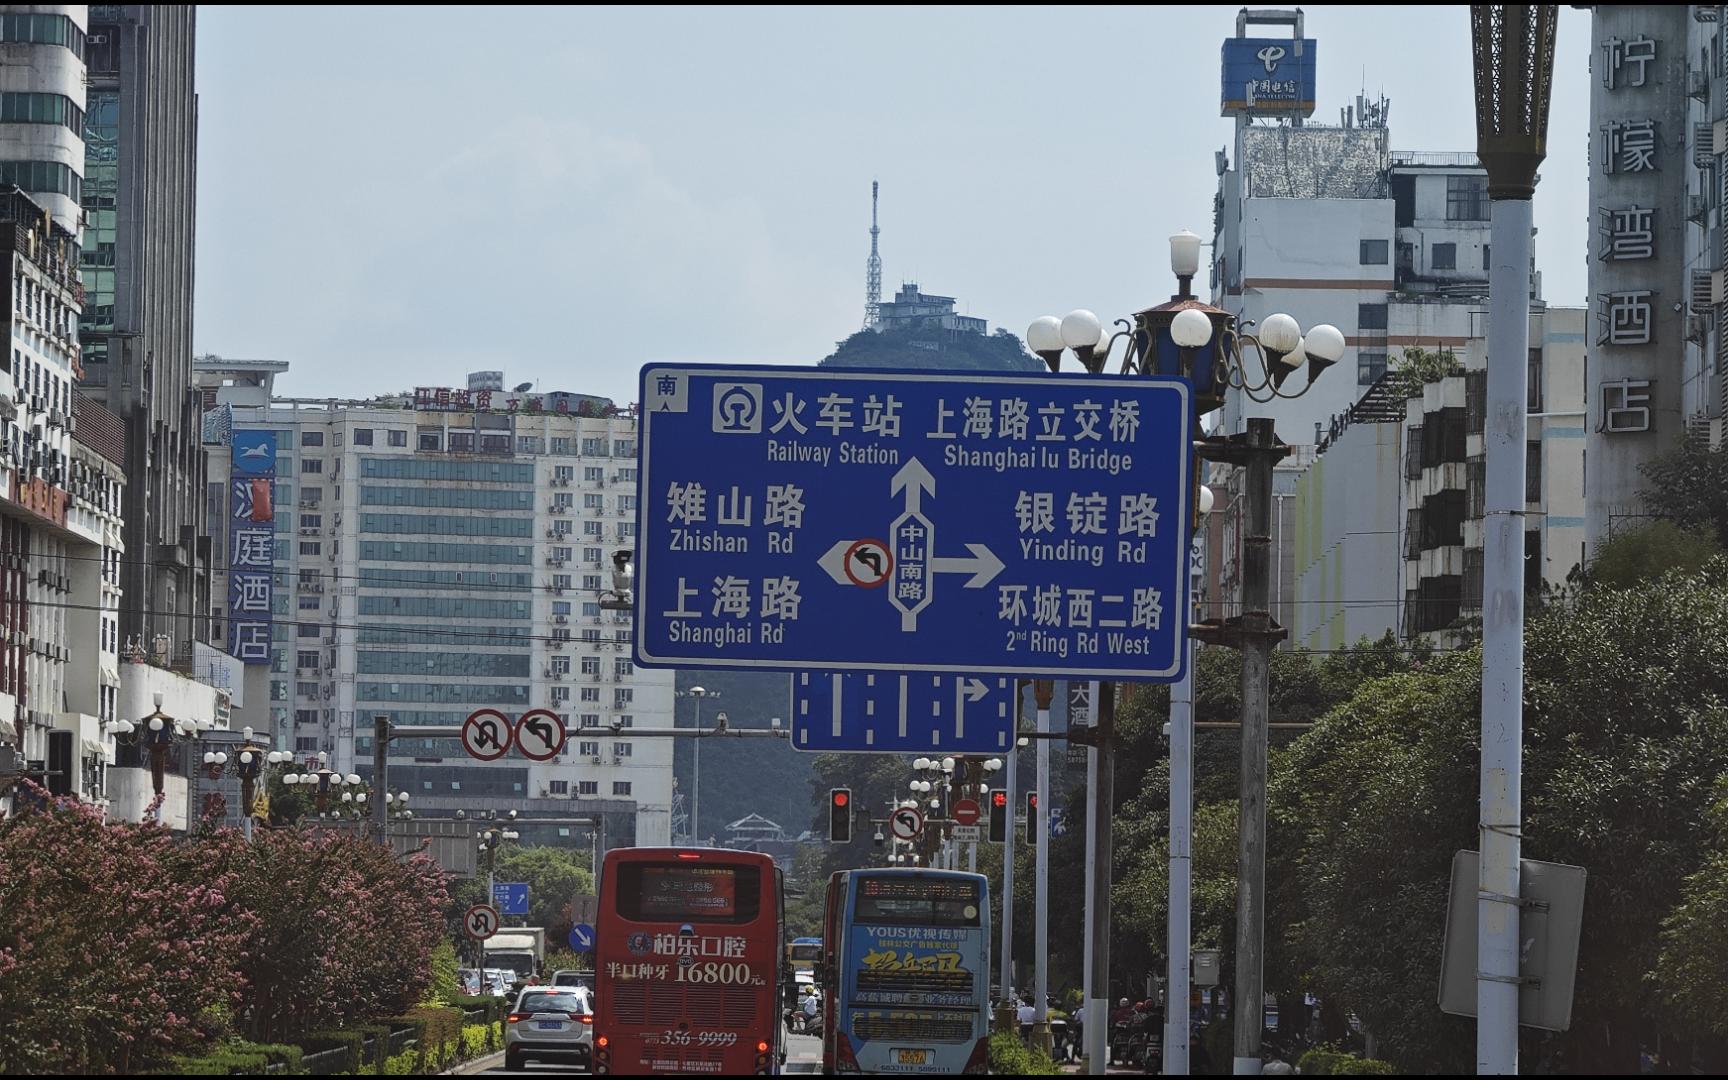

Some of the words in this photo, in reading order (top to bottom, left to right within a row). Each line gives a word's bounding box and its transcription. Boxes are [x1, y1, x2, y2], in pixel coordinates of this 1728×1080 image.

[1595, 34, 1656, 433] 柠檬湾酒店
[656, 375, 678, 396] 南
[769, 392, 903, 437] 火车站
[926, 397, 1140, 442] 上海路立交桥
[767, 440, 831, 467] Railway
[839, 441, 898, 464] Station
[944, 444, 1036, 472] Shanghai
[1068, 448, 1132, 475] Bridge
[667, 481, 806, 528] 雉山路
[1015, 490, 1160, 537] 银锭路
[669, 529, 748, 553] Zhishan
[768, 532, 793, 554] Rd
[1020, 538, 1104, 567] Yinding
[1118, 541, 1146, 563] Rd
[897, 524, 924, 600] 中山南路
[663, 575, 802, 620] 上海路
[998, 584, 1163, 630] 环城西二路
[668, 620, 752, 647] Shanghai
[761, 623, 784, 644] Rd
[1006, 630, 1027, 652] 2nd
[1030, 631, 1068, 658] Ring
[1077, 632, 1098, 654] Rd
[1108, 632, 1150, 656] West
[653, 933, 746, 957] 柏乐口腔
[866, 927, 906, 938] YOUS
[605, 962, 669, 980] 半口种牙
[660, 1030, 737, 1047] 356-9999
